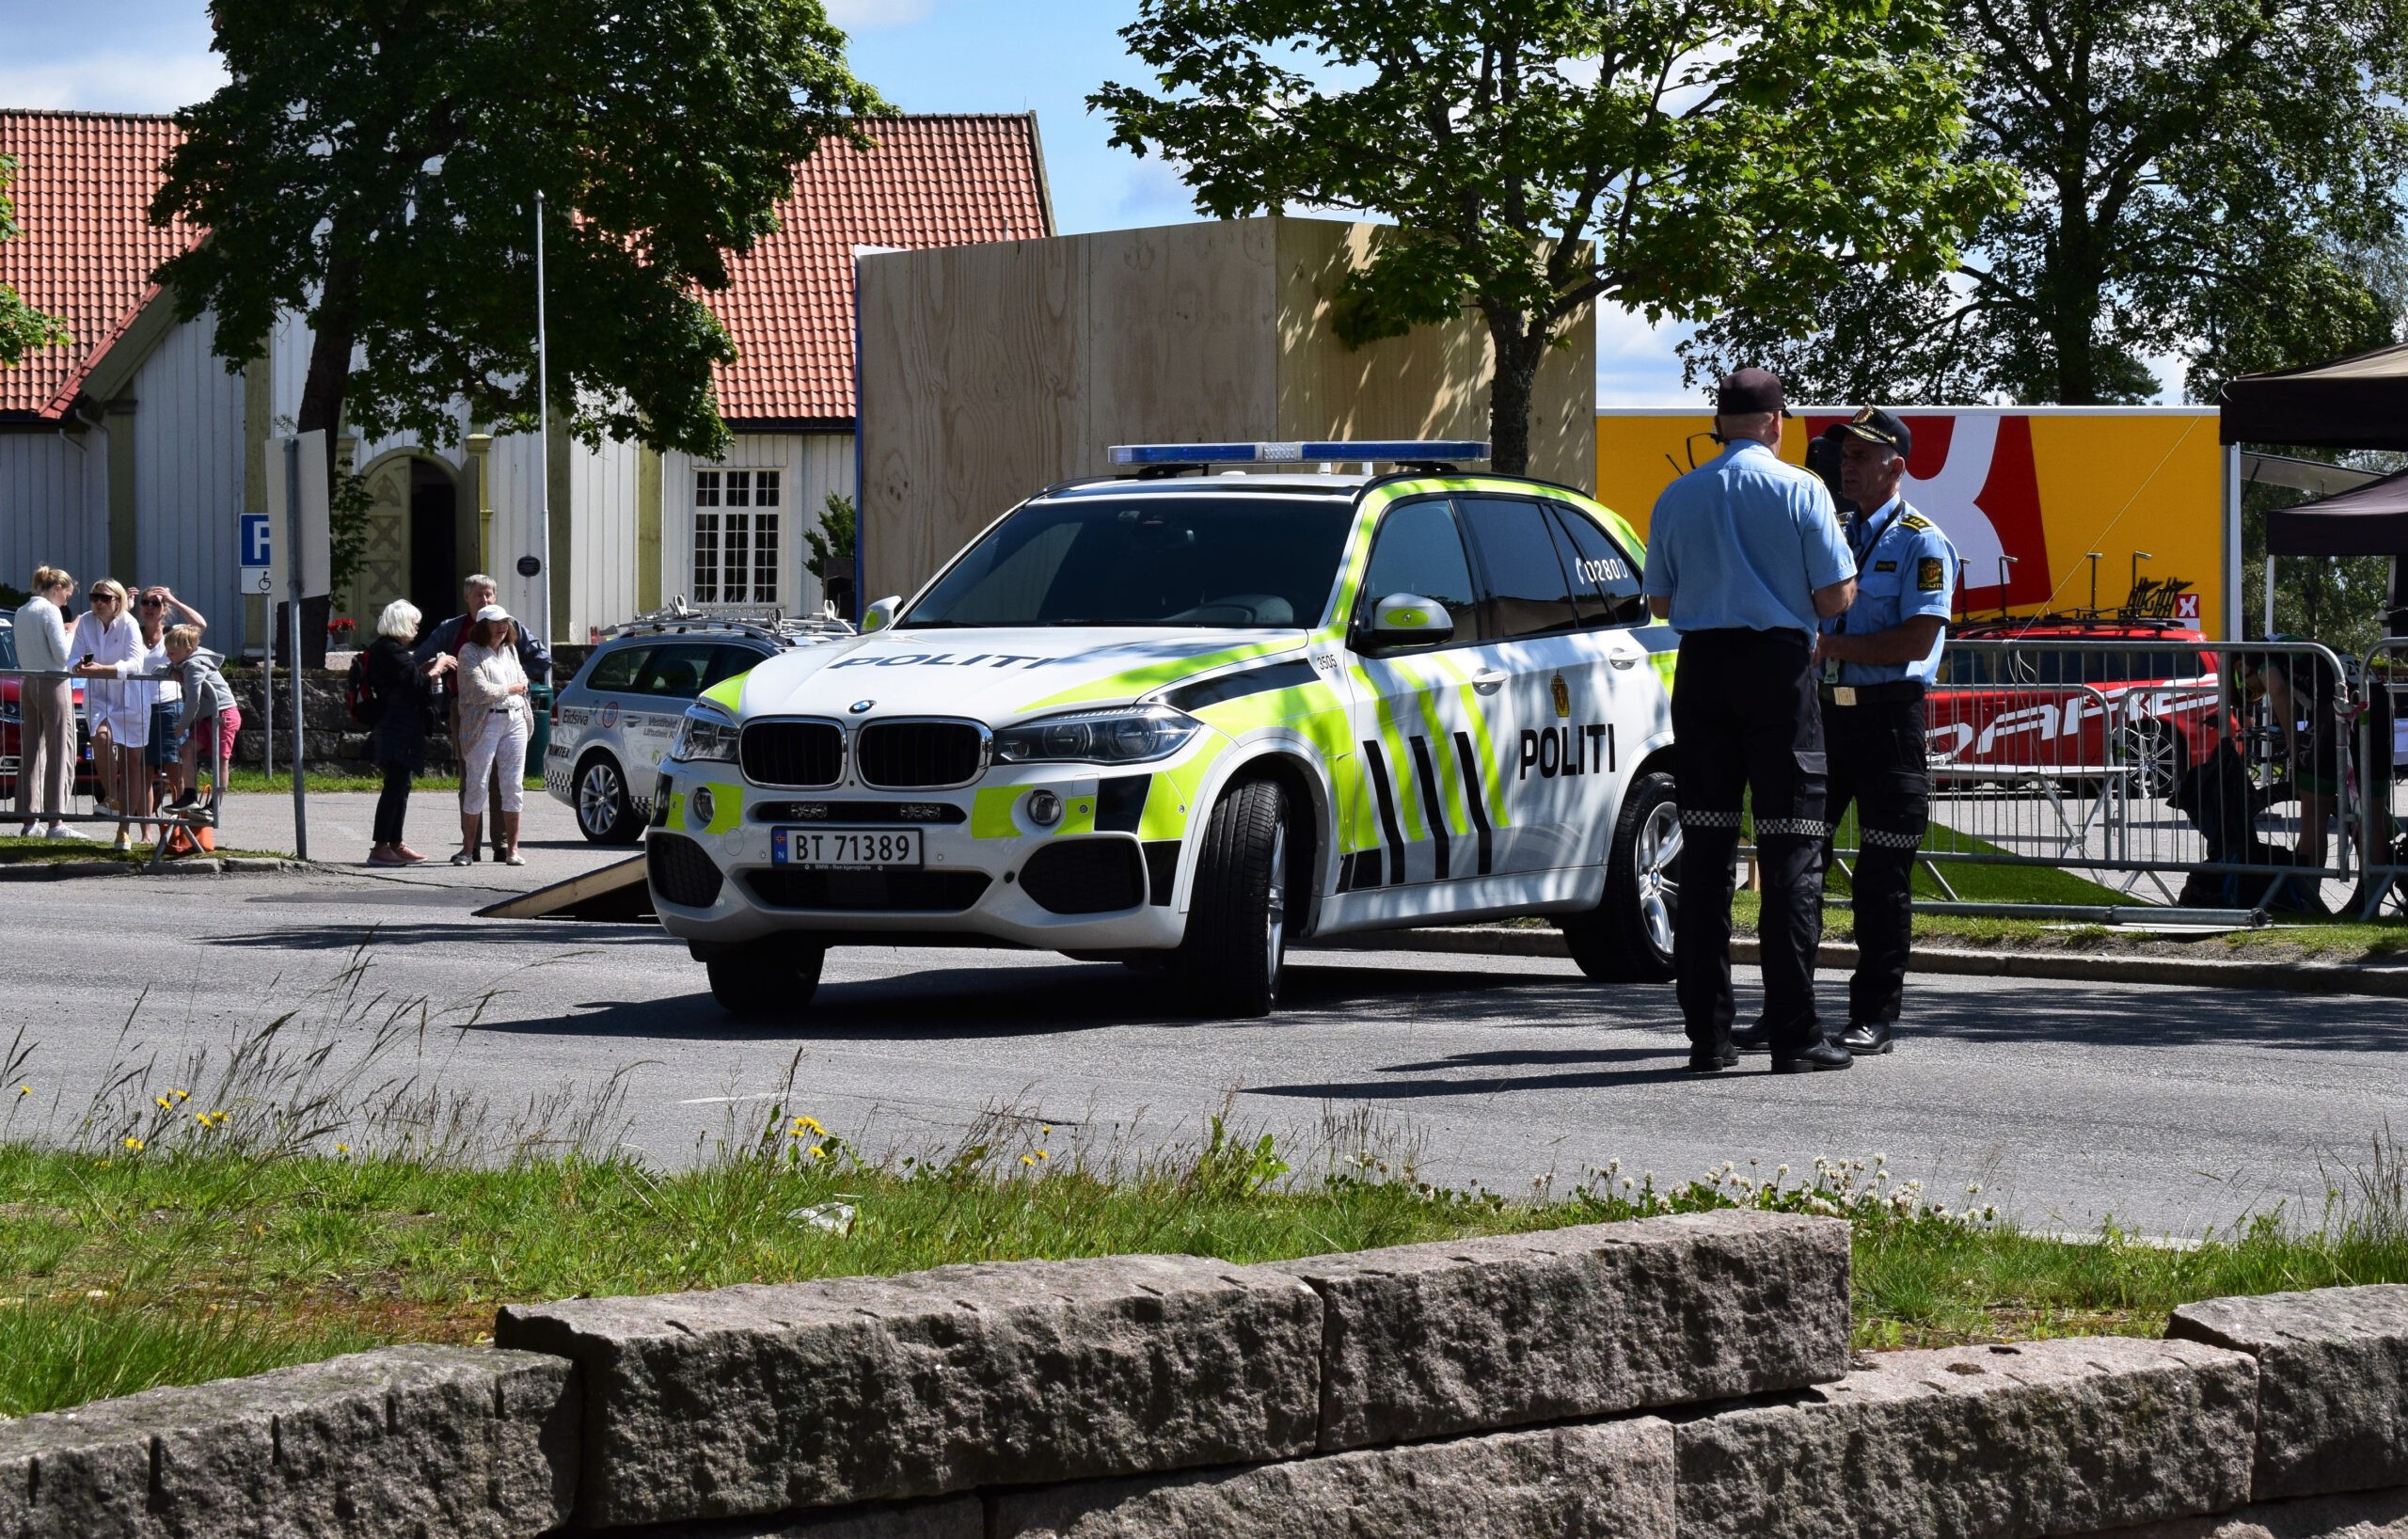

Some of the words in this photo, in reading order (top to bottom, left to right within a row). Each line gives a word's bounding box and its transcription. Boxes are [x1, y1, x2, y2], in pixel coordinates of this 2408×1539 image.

[1584, 558, 1628, 582] 02800
[827, 654, 1062, 670] POLITI
[1317, 654, 1338, 671] 3505
[562, 708, 589, 726] Eidsiva
[1520, 723, 1616, 780] POLITI
[796, 834, 824, 861] BT
[834, 834, 910, 861] 71389
